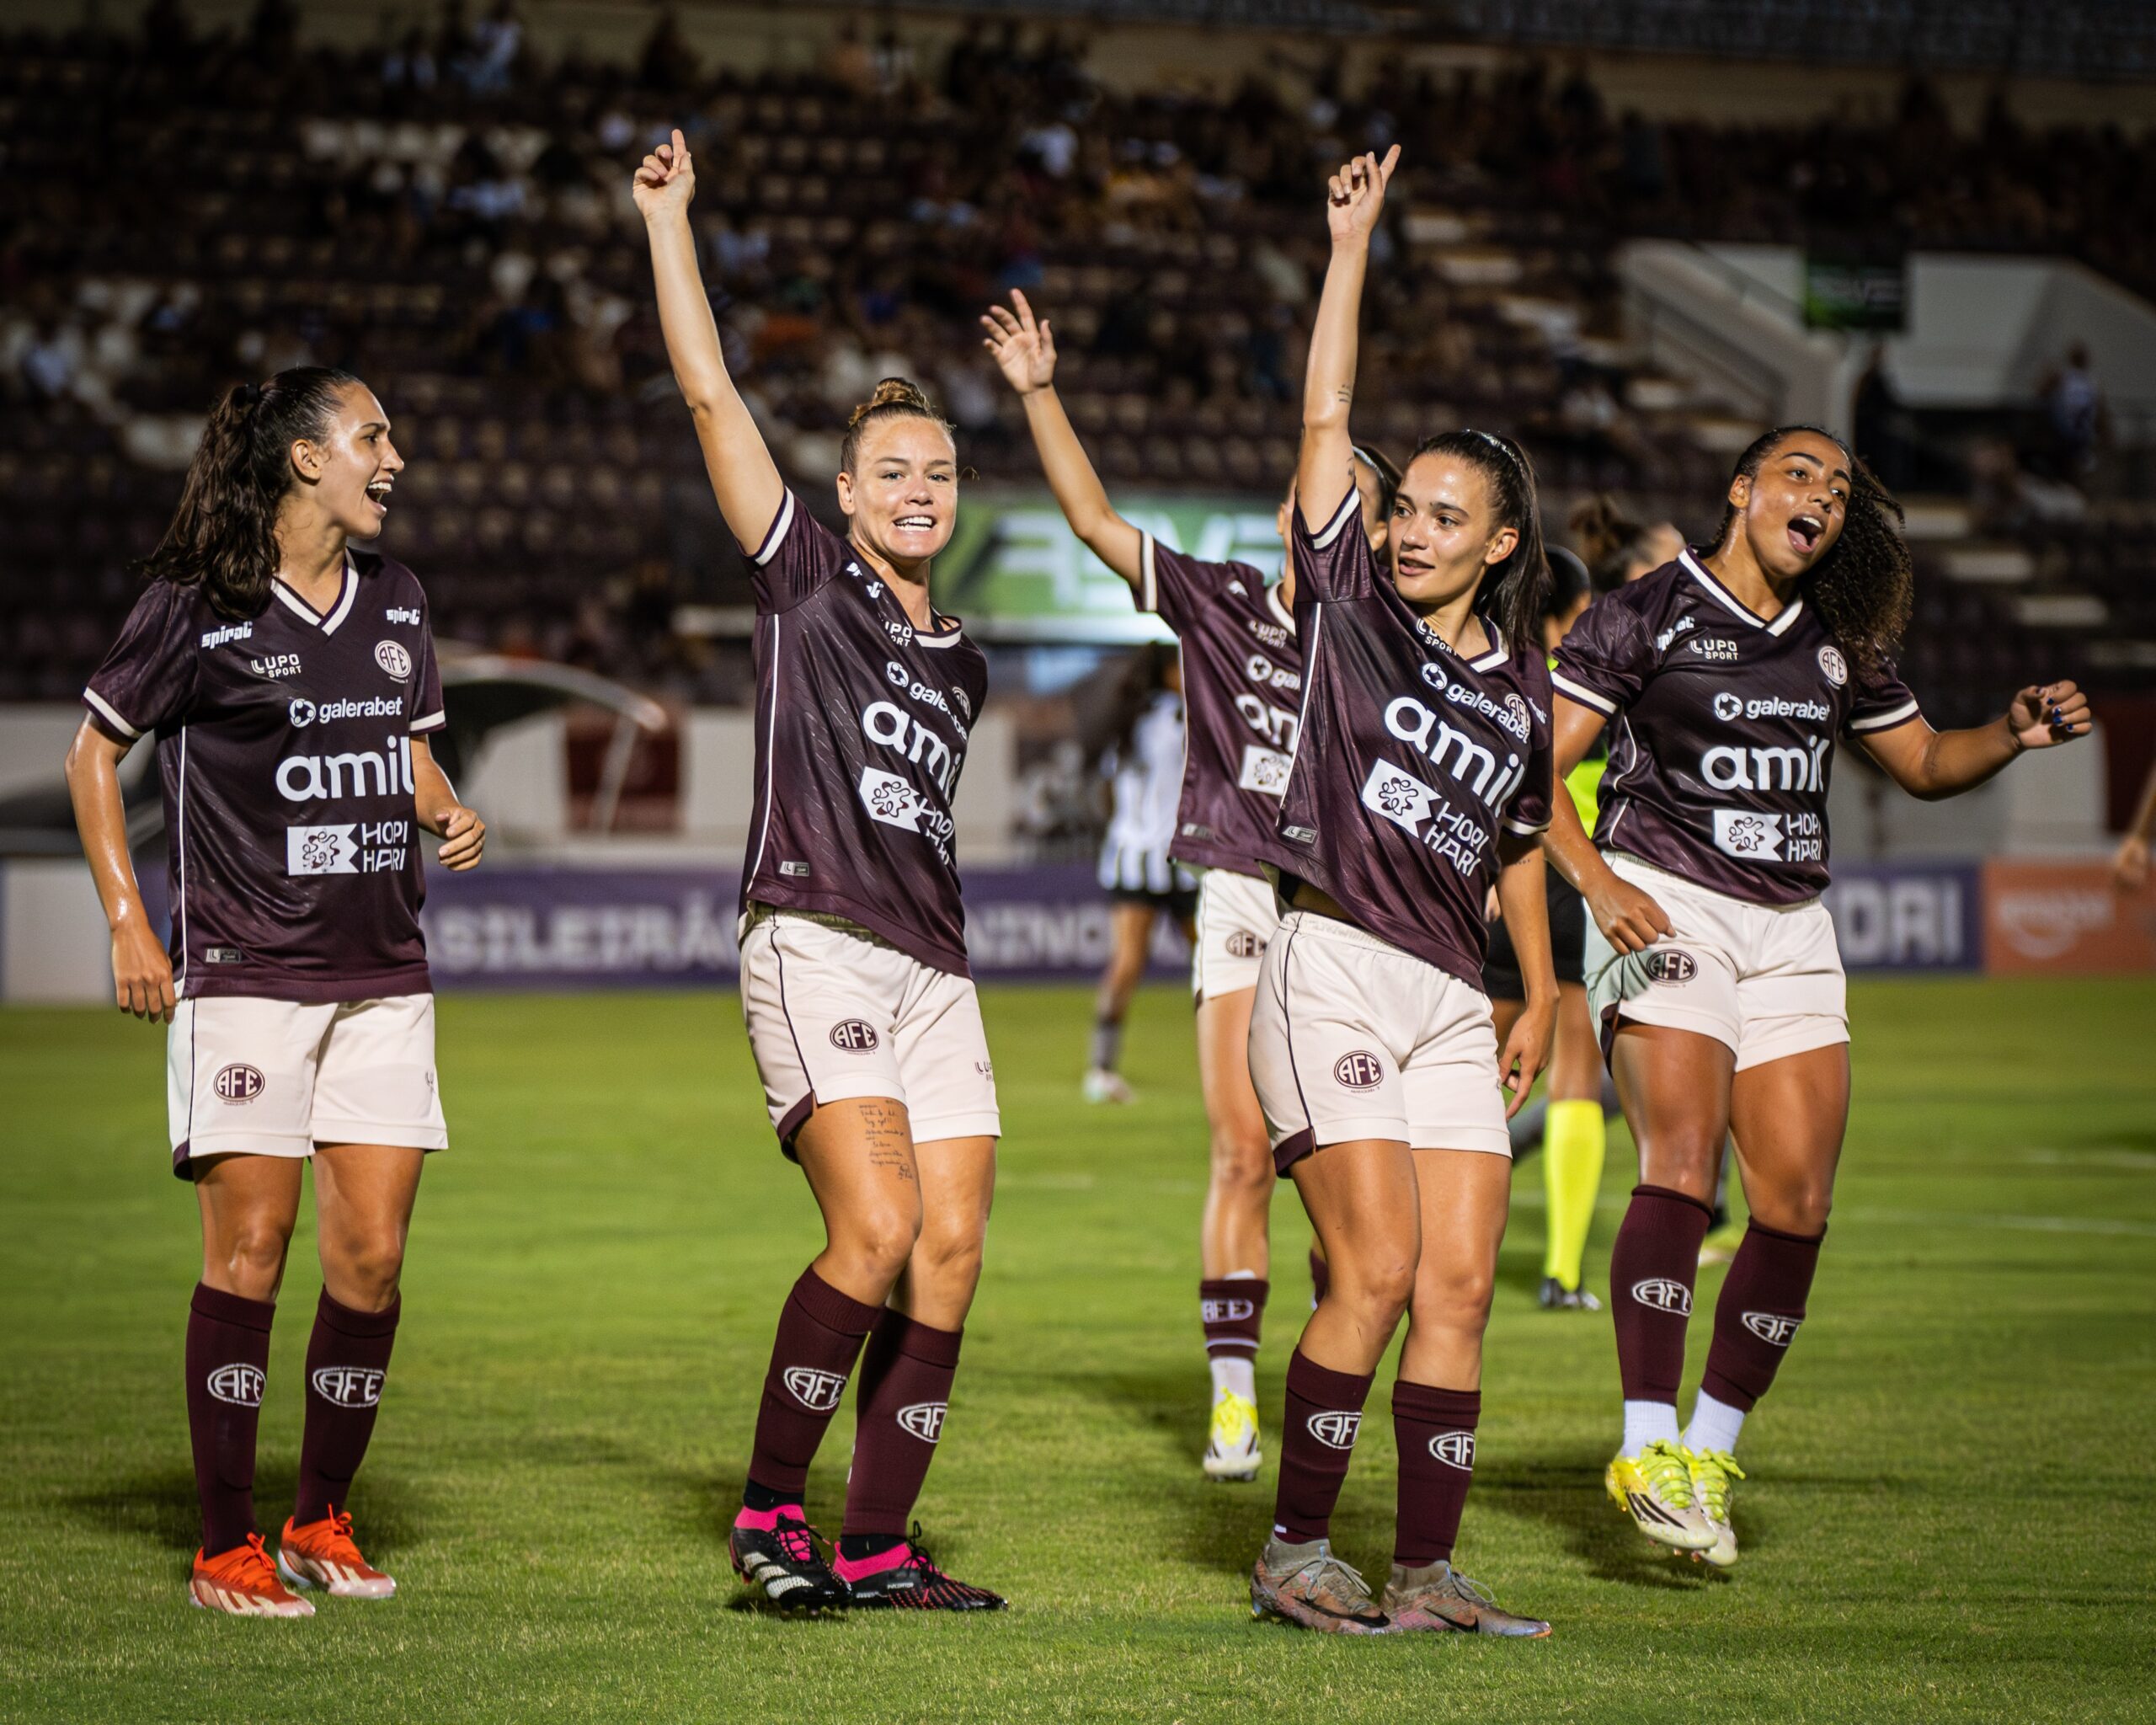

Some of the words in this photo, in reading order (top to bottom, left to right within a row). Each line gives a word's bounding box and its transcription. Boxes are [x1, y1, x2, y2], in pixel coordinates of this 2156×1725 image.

[201, 621, 252, 649] spiral
[1690, 639, 1737, 654] LUPO
[251, 654, 300, 674] LUPO
[379, 645, 406, 671] AFE
[1705, 652, 1738, 660] SPORT
[1822, 651, 1844, 679] AFE
[268, 665, 302, 678] SPORT
[319, 697, 403, 724] galerabet
[1747, 696, 1830, 721] galerabet
[275, 735, 415, 801] amil
[1701, 734, 1830, 793] amil
[362, 821, 408, 845] HOPI
[1436, 801, 1489, 854] HOPI
[363, 848, 406, 873] HARI
[1424, 824, 1481, 877] HARI
[1788, 840, 1822, 862] HARI
[1651, 953, 1692, 980] AFE
[834, 1023, 875, 1049] AFE
[216, 1068, 258, 1097] AFE
[1338, 1055, 1380, 1084] AFE
[1750, 1317, 1799, 1343] AF
[215, 1370, 264, 1401] AFE
[319, 1371, 382, 1402] AFE
[905, 1407, 947, 1438] AF
[1315, 1416, 1361, 1445] AF
[1437, 1436, 1476, 1466] AF
